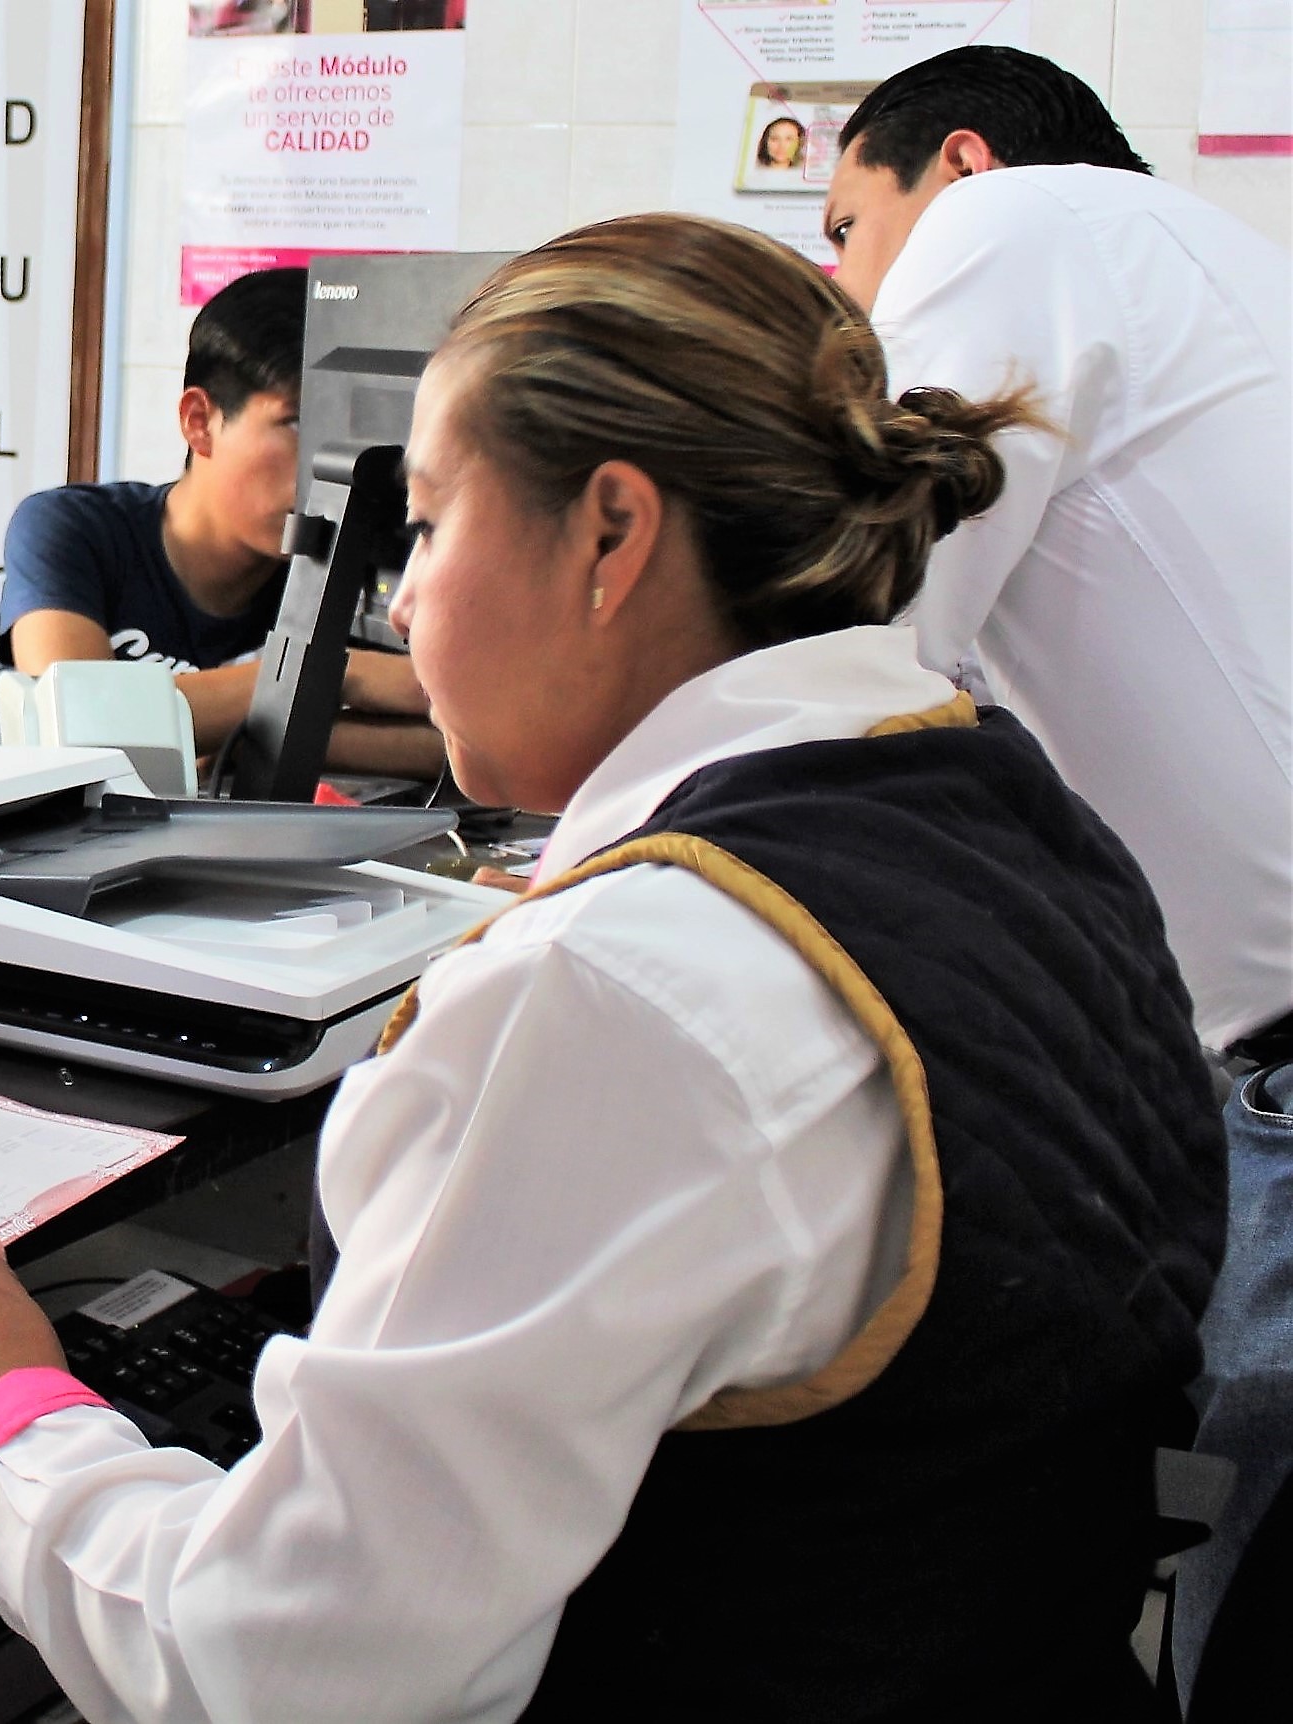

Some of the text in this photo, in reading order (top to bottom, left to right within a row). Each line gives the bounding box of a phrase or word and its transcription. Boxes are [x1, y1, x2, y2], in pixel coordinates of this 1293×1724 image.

[270, 57, 313, 78] este
[319, 54, 408, 76] Módulo
[275, 81, 393, 102] ofrecemos
[245, 105, 395, 128] un servicio de
[265, 130, 371, 151] CALIDAD
[314, 280, 359, 300] lenovo
